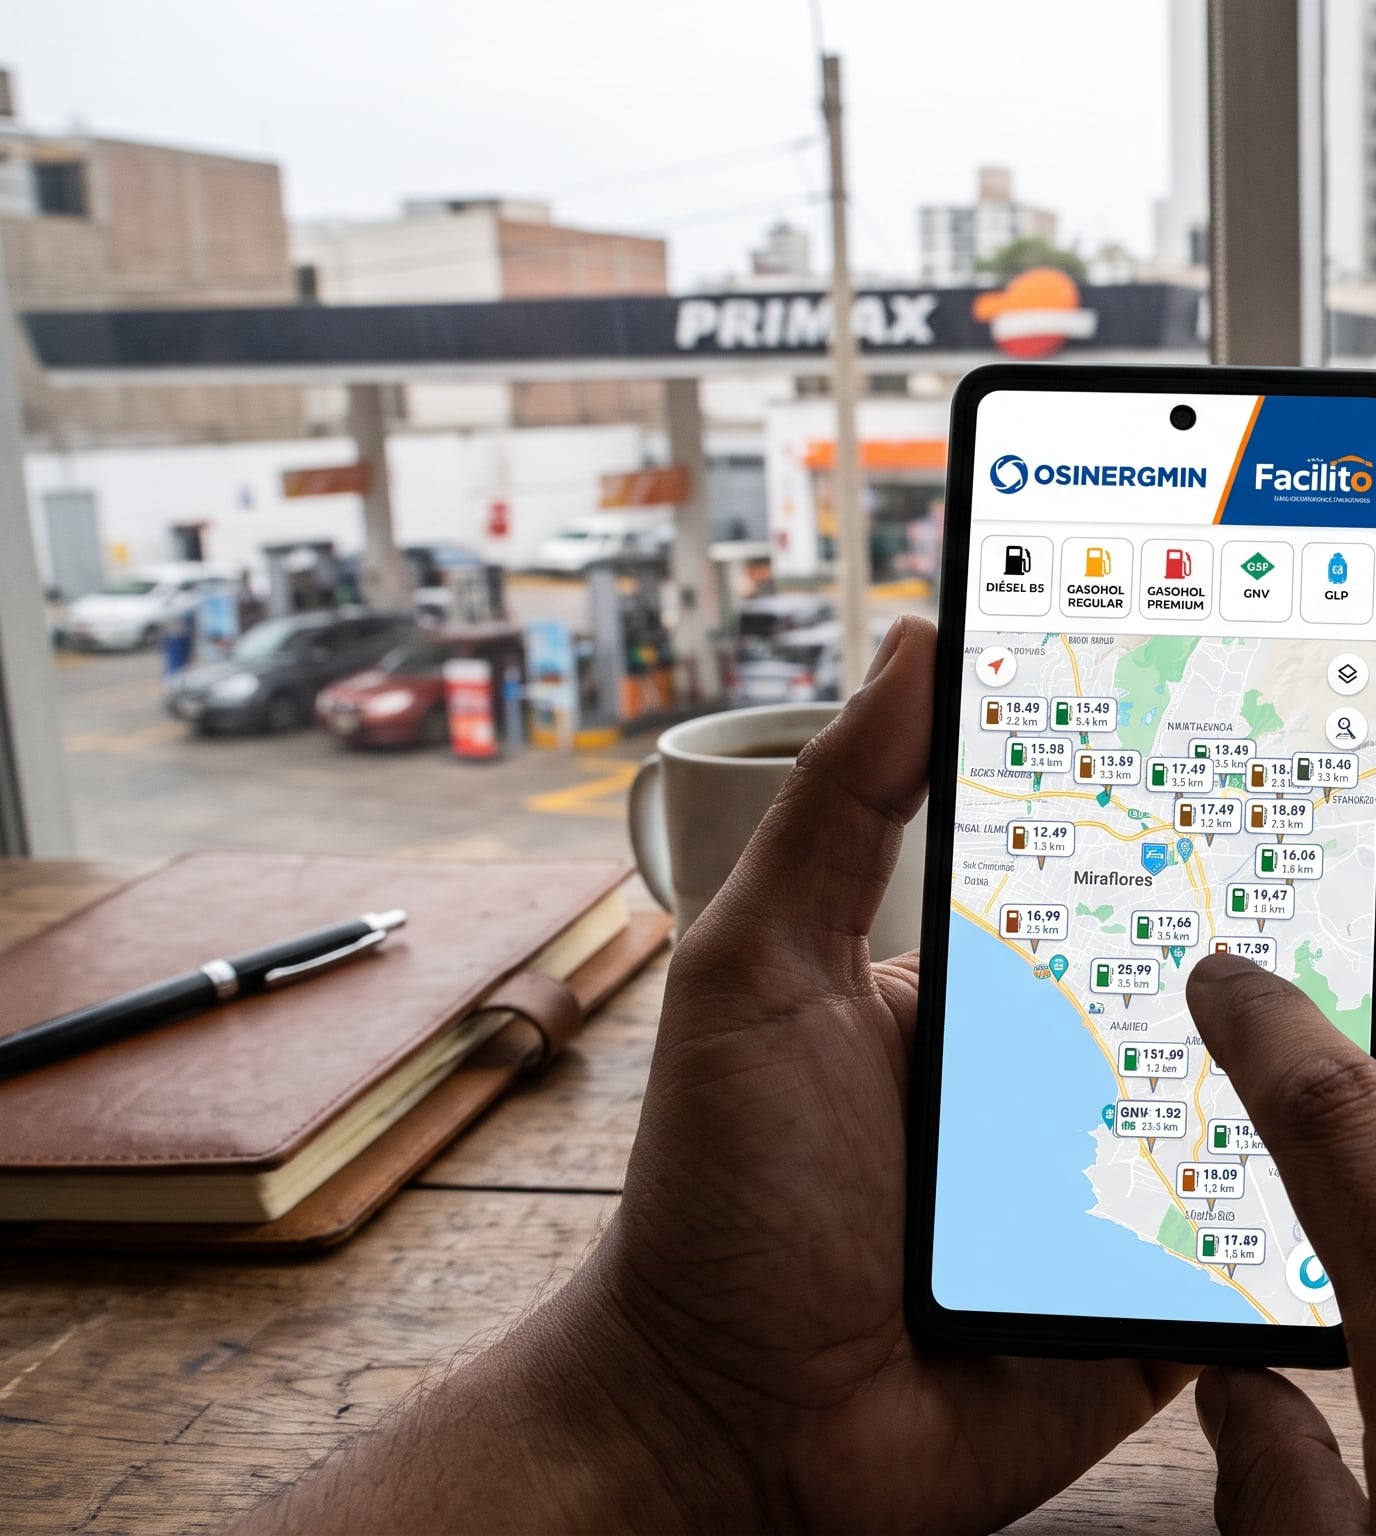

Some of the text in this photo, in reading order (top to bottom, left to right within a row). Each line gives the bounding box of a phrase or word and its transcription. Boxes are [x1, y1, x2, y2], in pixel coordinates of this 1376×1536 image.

[675, 294, 938, 349] PRIMAX
[1034, 464, 1207, 489] OSINERGMIN
[1255, 463, 1373, 493] Facilito
[986, 580, 1045, 593] DIÉSEL B5
[1067, 584, 1125, 595] GASOHOL
[1147, 587, 1206, 597] GASOHOL
[1243, 589, 1270, 598] GNV
[1324, 591, 1349, 600] GLP
[1068, 598, 1123, 608] REGULAR
[1147, 600, 1204, 610] PREMIUM
[1006, 702, 1040, 713] 18.49
[1076, 702, 1110, 713] 15.49
[1006, 717, 1038, 726] 2.2 km
[1076, 717, 1108, 726] 5.4 km
[1215, 744, 1249, 756] 13.49
[1172, 763, 1206, 774] 17.49
[1215, 759, 1229, 768] 3.5
[1100, 770, 1131, 779] 3.3 km
[1272, 764, 1290, 775] 18.
[1172, 778, 1203, 787] 3.5 km
[1333, 773, 1348, 782] km
[1200, 804, 1234, 815] 17.49
[1272, 804, 1306, 816] 18.89
[1216, 819, 1232, 828] km
[1288, 820, 1304, 829] km
[1034, 827, 1067, 838] 12.49
[1282, 849, 1316, 861] 16.06
[1298, 865, 1313, 874] km
[1074, 870, 1153, 887] Miraflores
[1269, 905, 1285, 914] km
[1026, 925, 1059, 934] 2.5 km
[1157, 932, 1171, 941] 3.5
[1155, 1108, 1181, 1119] 1.92
[1163, 1122, 1178, 1131] km
[1204, 1169, 1238, 1180] 18.09
[1220, 1184, 1235, 1193] km
[1240, 1249, 1255, 1259] km
